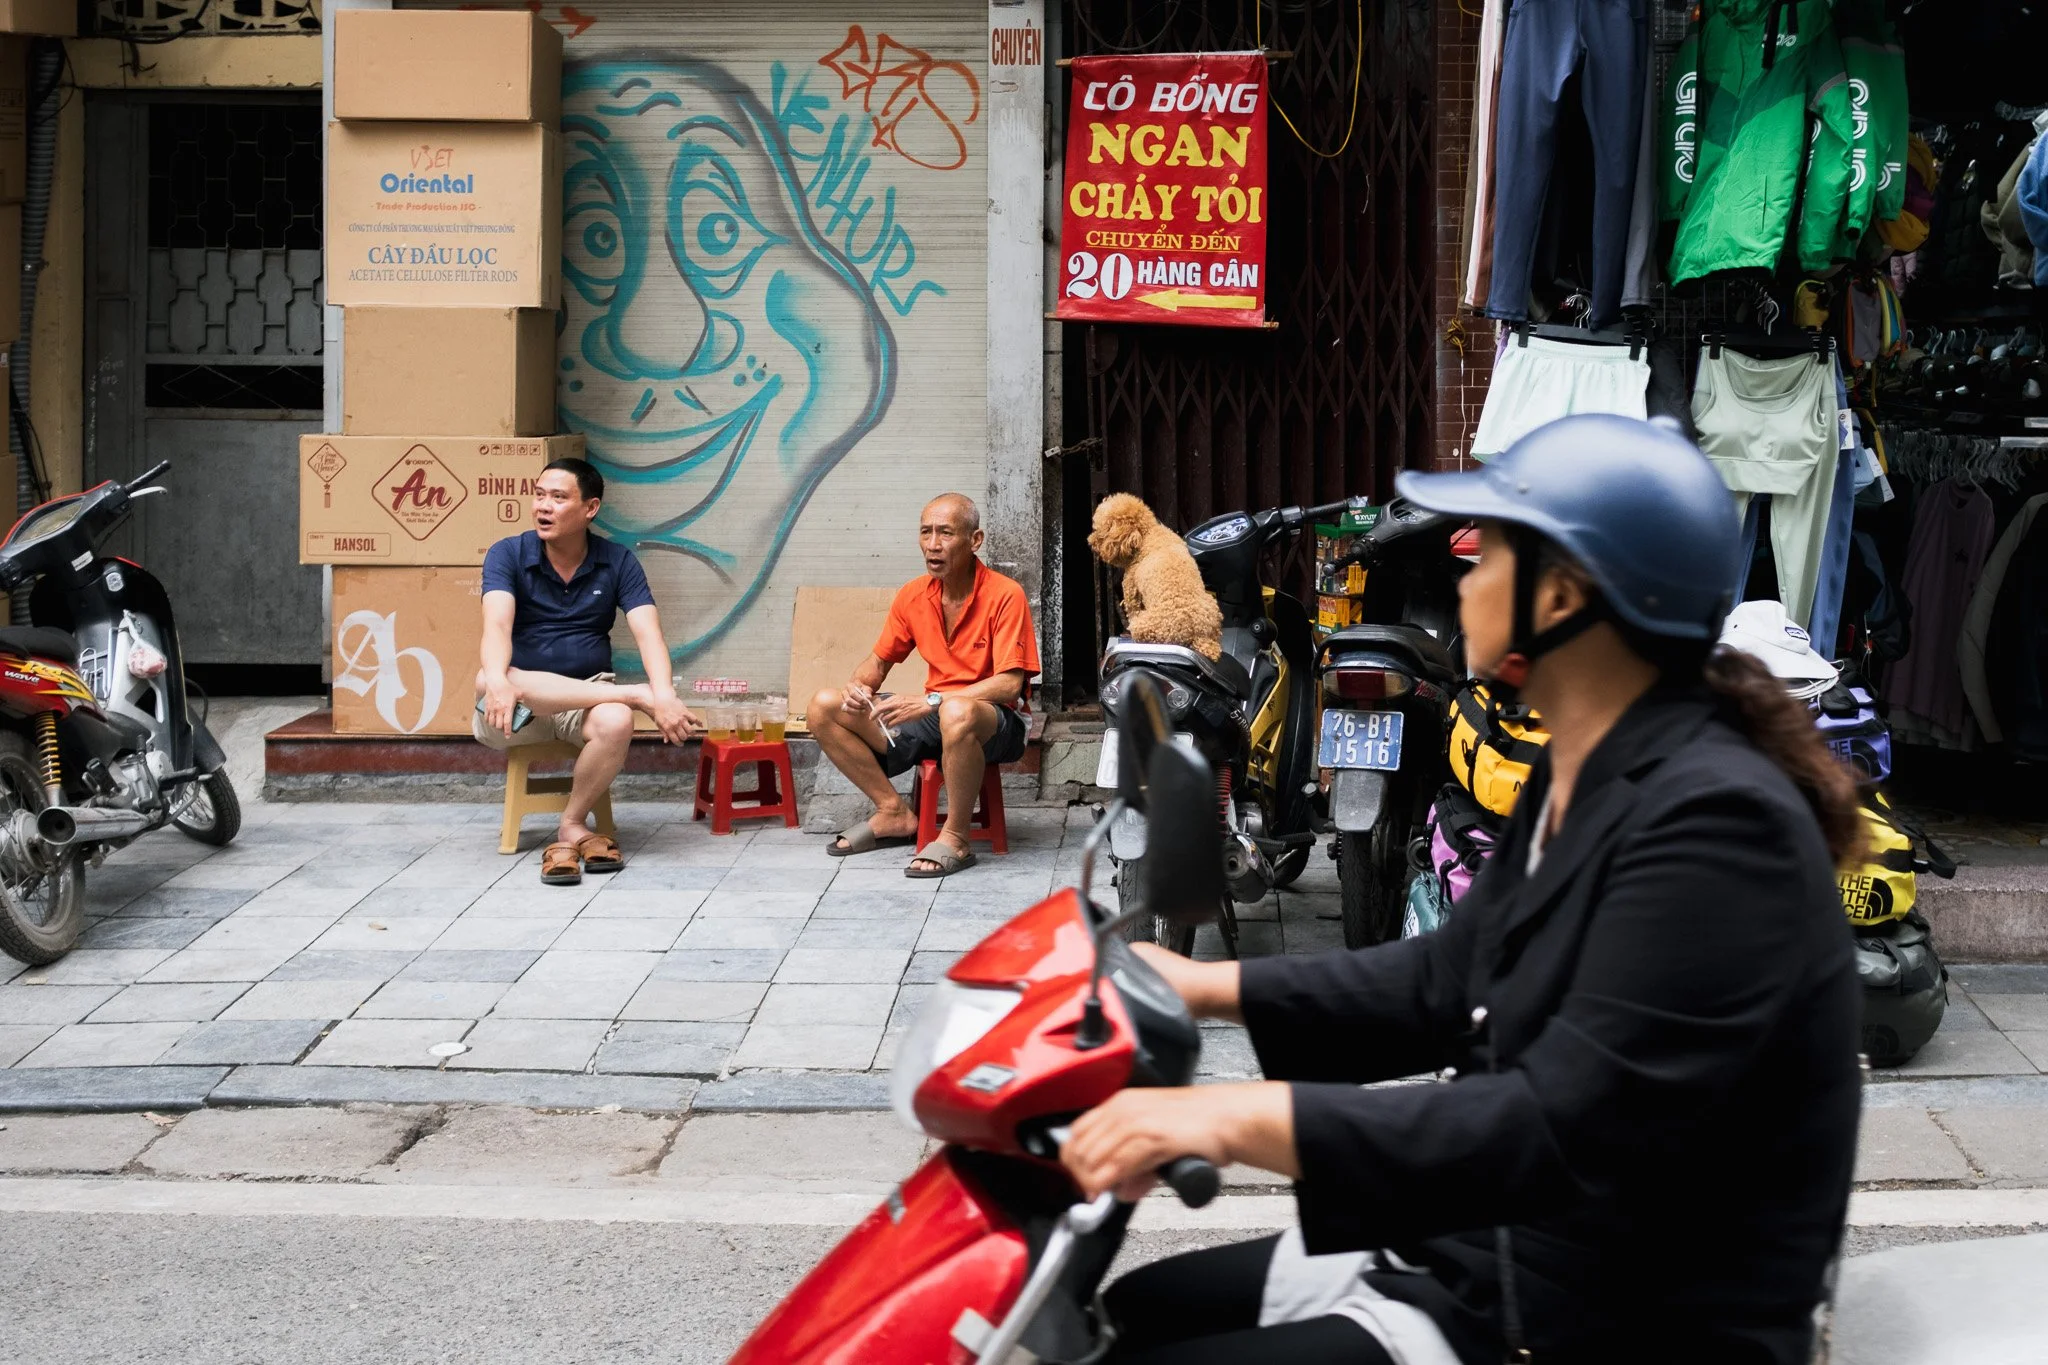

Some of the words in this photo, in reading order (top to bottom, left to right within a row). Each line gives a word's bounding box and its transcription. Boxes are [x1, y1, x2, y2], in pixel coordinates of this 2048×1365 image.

[992, 18, 1041, 66] CHUYÊN
[1083, 74, 1137, 112] CÔ
[1150, 73, 1259, 114] BỐNG
[1087, 122, 1252, 168] NGAN
[380, 172, 474, 194] Oriental
[375, 202, 403, 211] Trade
[406, 202, 458, 211] Production
[1069, 173, 1182, 220] CHÁY
[1191, 173, 1263, 224] TỎI
[1085, 223, 1184, 249] CHUYỂN
[1190, 228, 1242, 251] ĐẾN
[368, 243, 406, 265] CÂY
[457, 247, 498, 269] LỌC
[349, 269, 395, 282] ACETATE
[396, 269, 453, 282] CELLULOSE
[455, 269, 490, 282] FILTER
[491, 269, 518, 283] RODS
[1066, 251, 1134, 300] 20
[1137, 256, 1202, 286] HÀNG
[1209, 258, 1259, 288] CÂN
[391, 468, 453, 514] An
[478, 472, 515, 496] BÌNH
[505, 503, 513, 519] 8
[333, 537, 377, 552] HANSOL
[1840, 872, 1872, 890] THE
[1836, 887, 1869, 905] RTH
[1844, 903, 1865, 919] CE
